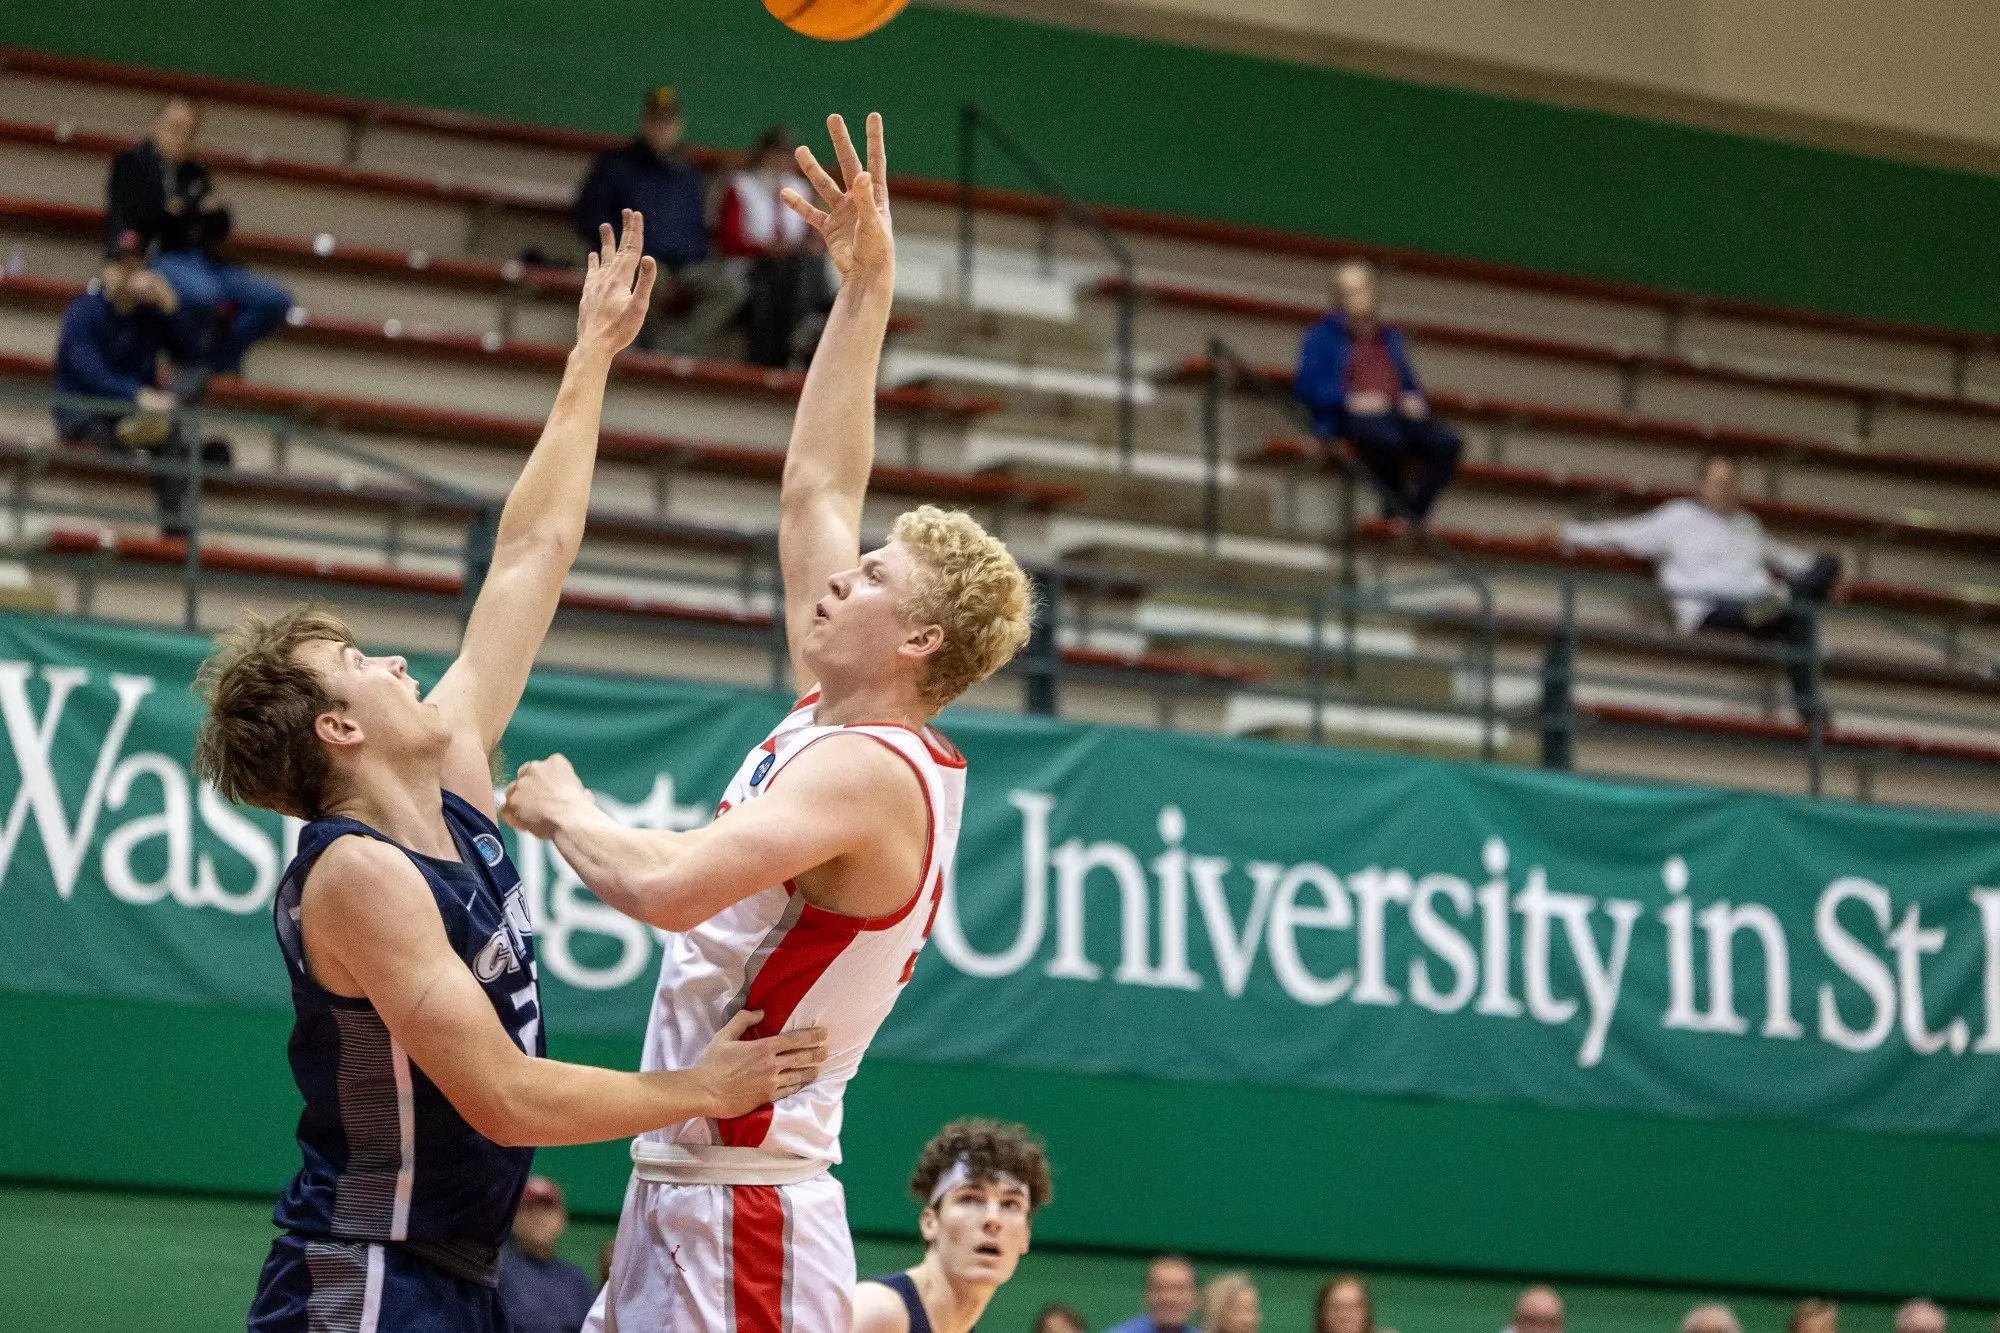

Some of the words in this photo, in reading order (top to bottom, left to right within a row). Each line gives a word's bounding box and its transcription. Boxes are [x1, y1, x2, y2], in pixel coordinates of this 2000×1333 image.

[932, 788, 1643, 1069] University
[1657, 855, 1803, 1039] in
[1816, 875, 1969, 1055] St.
